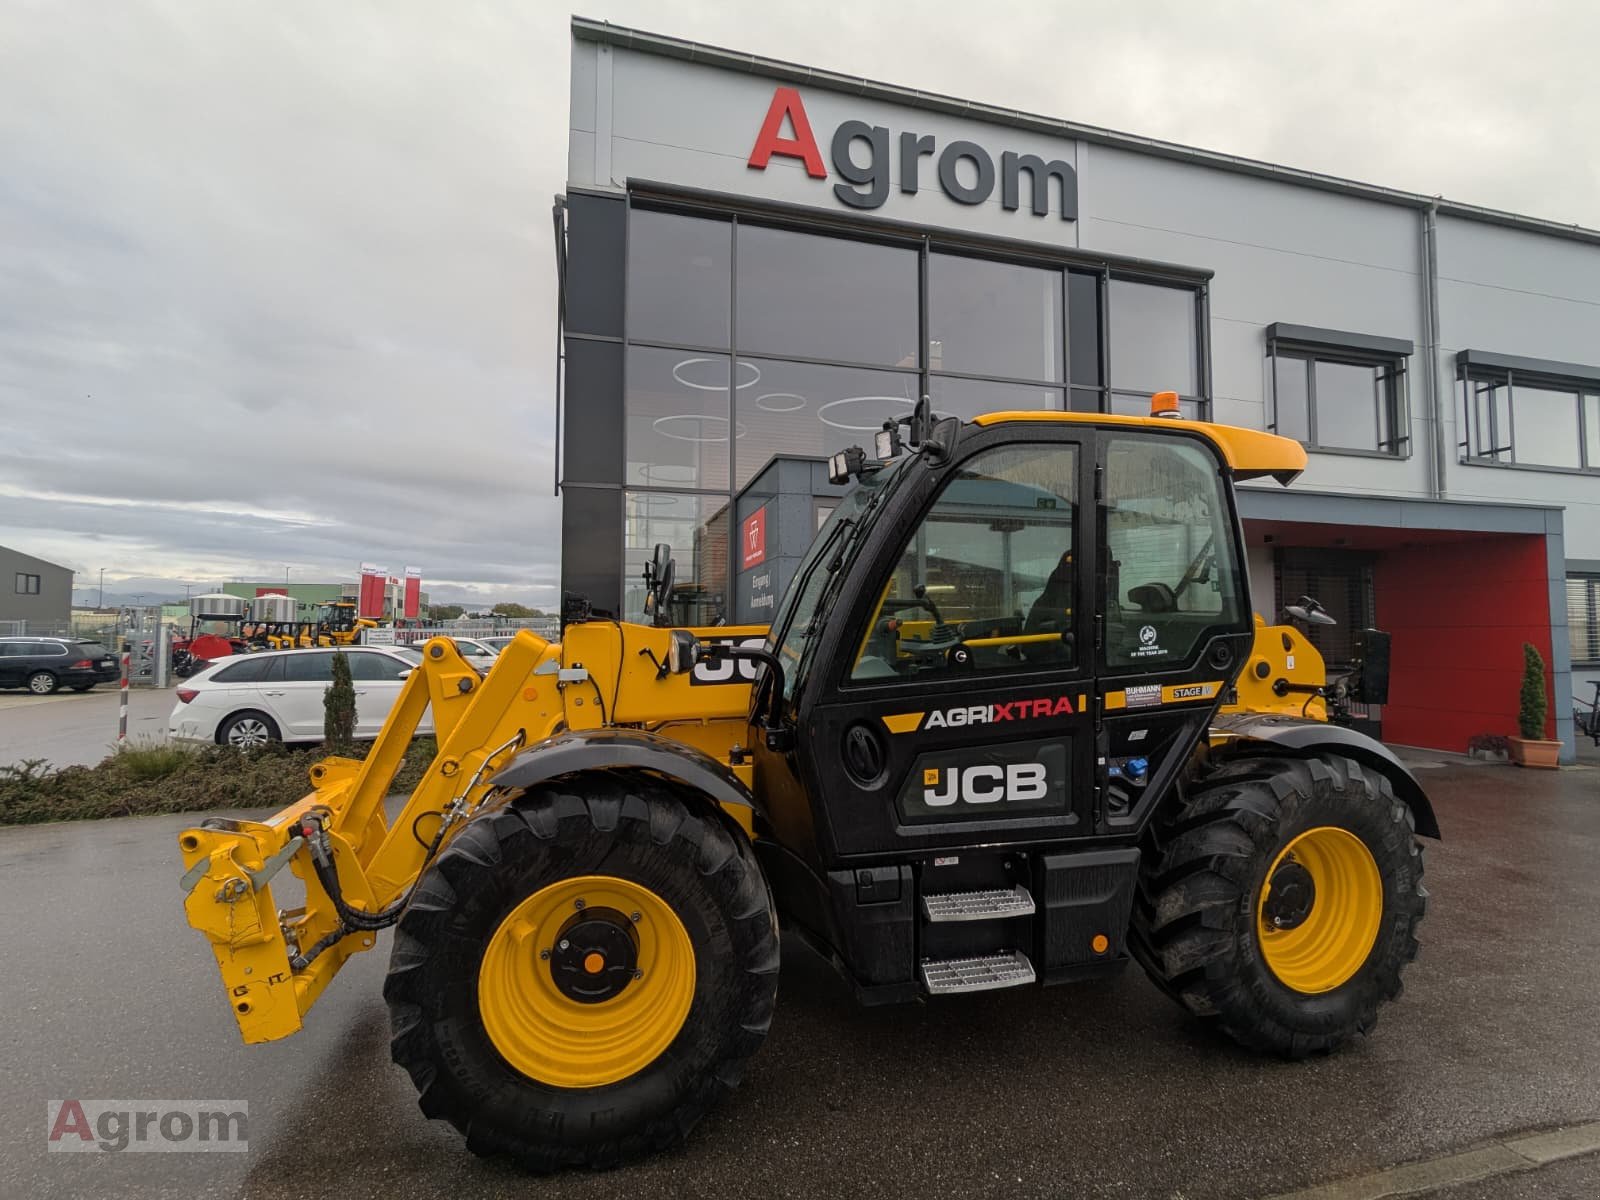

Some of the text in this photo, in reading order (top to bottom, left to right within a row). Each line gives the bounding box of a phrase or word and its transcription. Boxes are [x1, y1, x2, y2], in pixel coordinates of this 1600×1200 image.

[747, 86, 1078, 222] Agrom
[1125, 684, 1162, 695] BUHMANN
[1174, 687, 1201, 698] STAGE
[924, 696, 1074, 730] AGRIXTRA
[924, 763, 1048, 807] JCB
